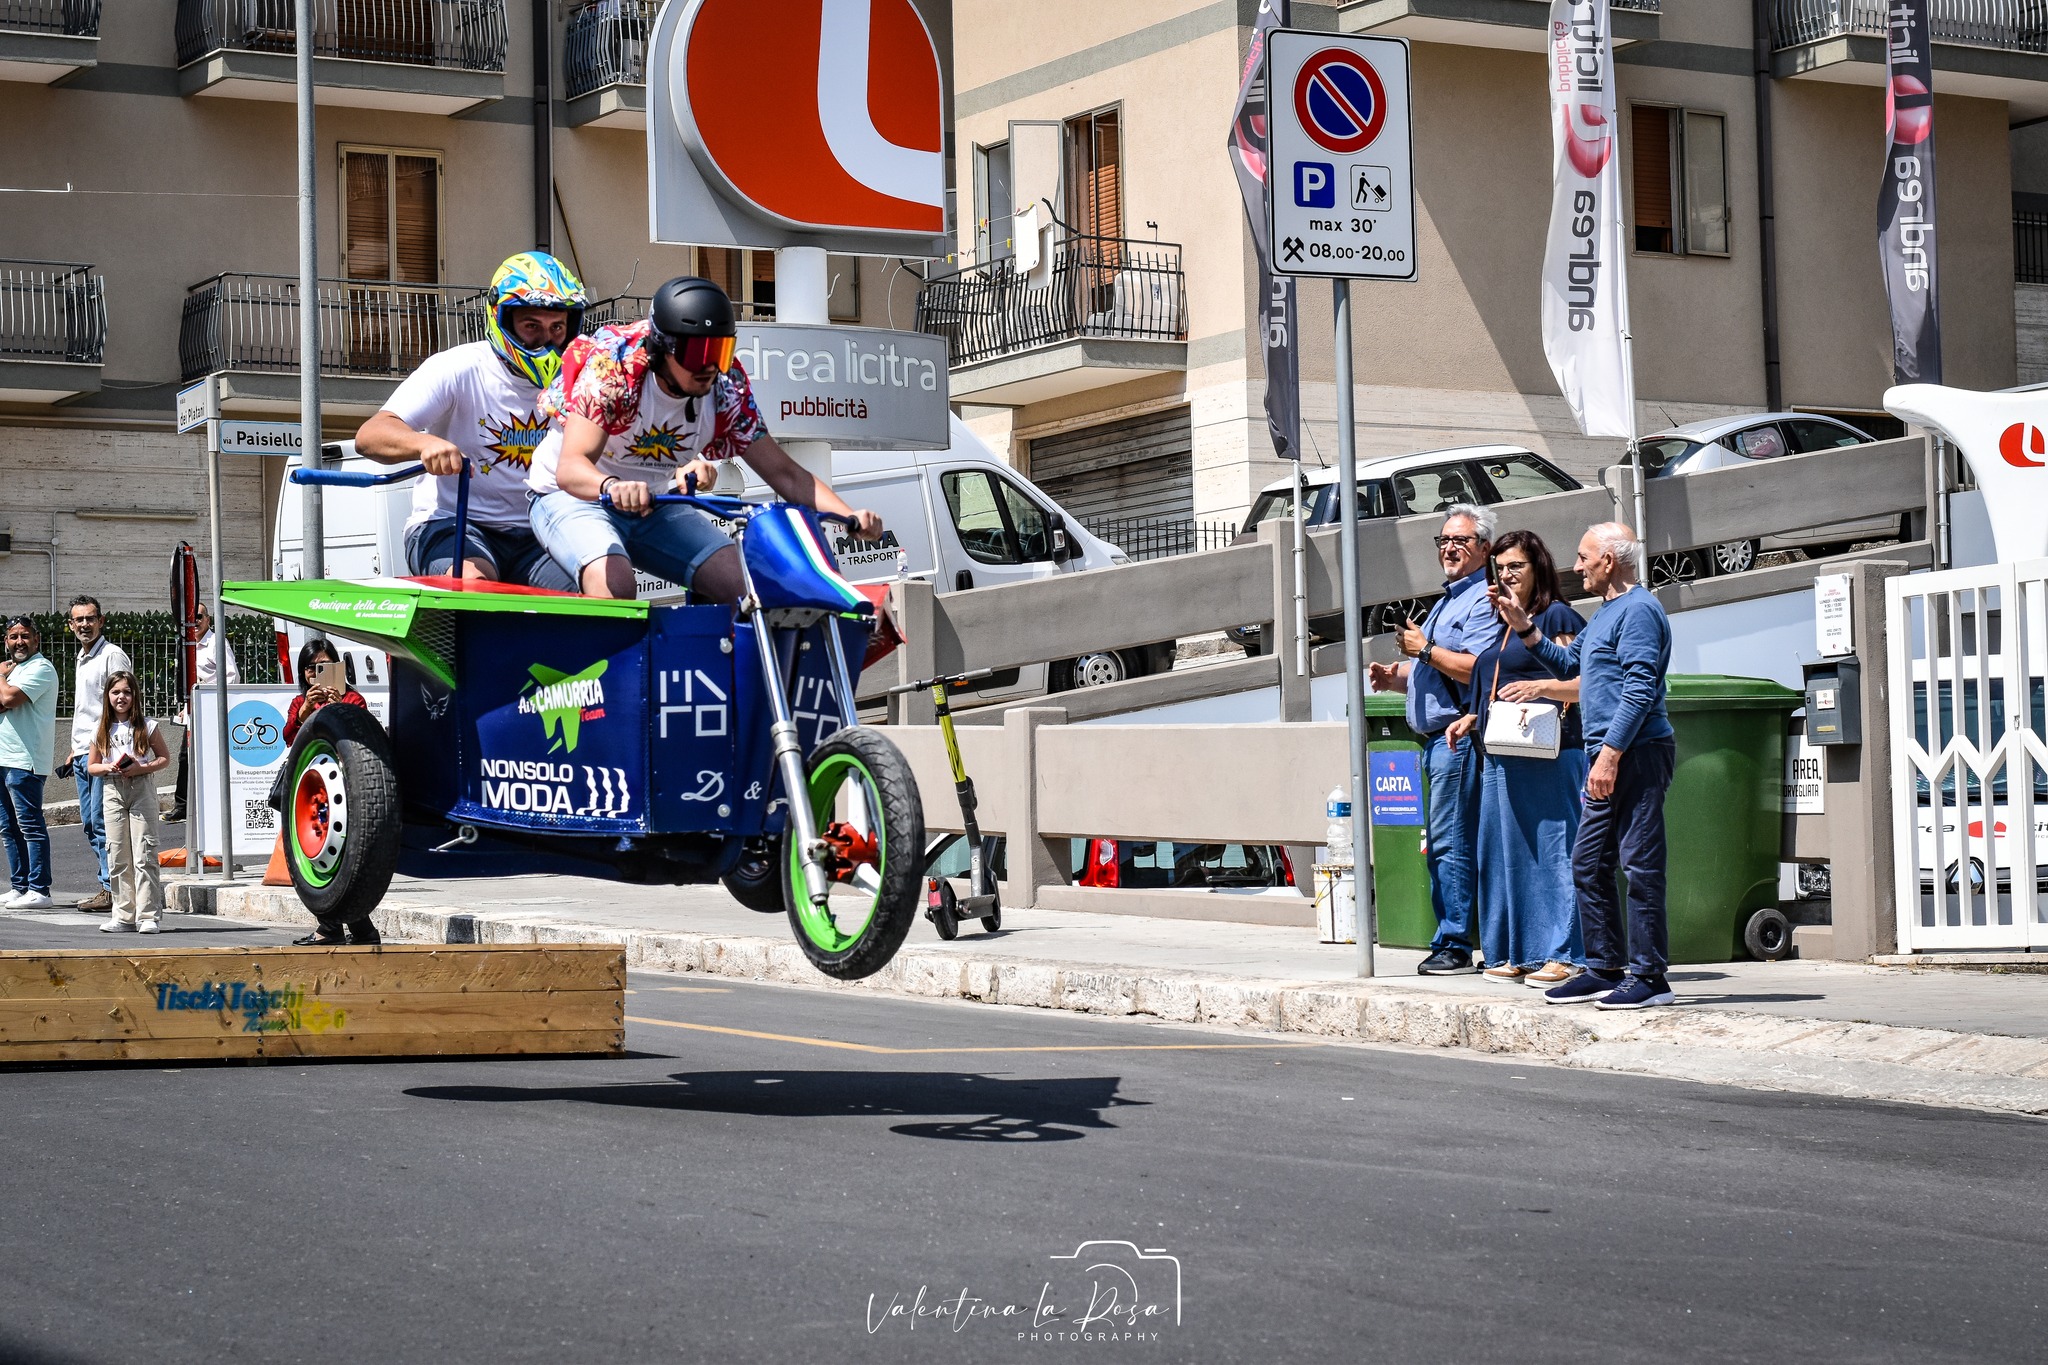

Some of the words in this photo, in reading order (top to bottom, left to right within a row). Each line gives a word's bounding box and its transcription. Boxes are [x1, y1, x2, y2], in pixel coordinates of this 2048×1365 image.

[1302, 167, 1326, 203] P
[1309, 219, 1343, 232] max
[1350, 218, 1377, 233] 30'
[735, 335, 836, 384] drea
[844, 338, 938, 392] licitra
[180, 409, 188, 427] dei
[188, 402, 205, 422] Platani
[780, 396, 868, 421] pubblicità
[223, 436, 232, 445] via
[236, 431, 302, 447] Paisiello
[847, 550, 901, 566] TRASPORT
[308, 598, 352, 613] Boutique
[353, 599, 375, 611] della
[378, 599, 410, 612] Carne
[517, 695, 537, 714] Air
[535, 678, 605, 713] CAMURRIA
[578, 708, 606, 722] Team
[480, 758, 573, 782] NONSOLO
[1375, 776, 1412, 792] CARTA
[481, 780, 574, 815] MODA
